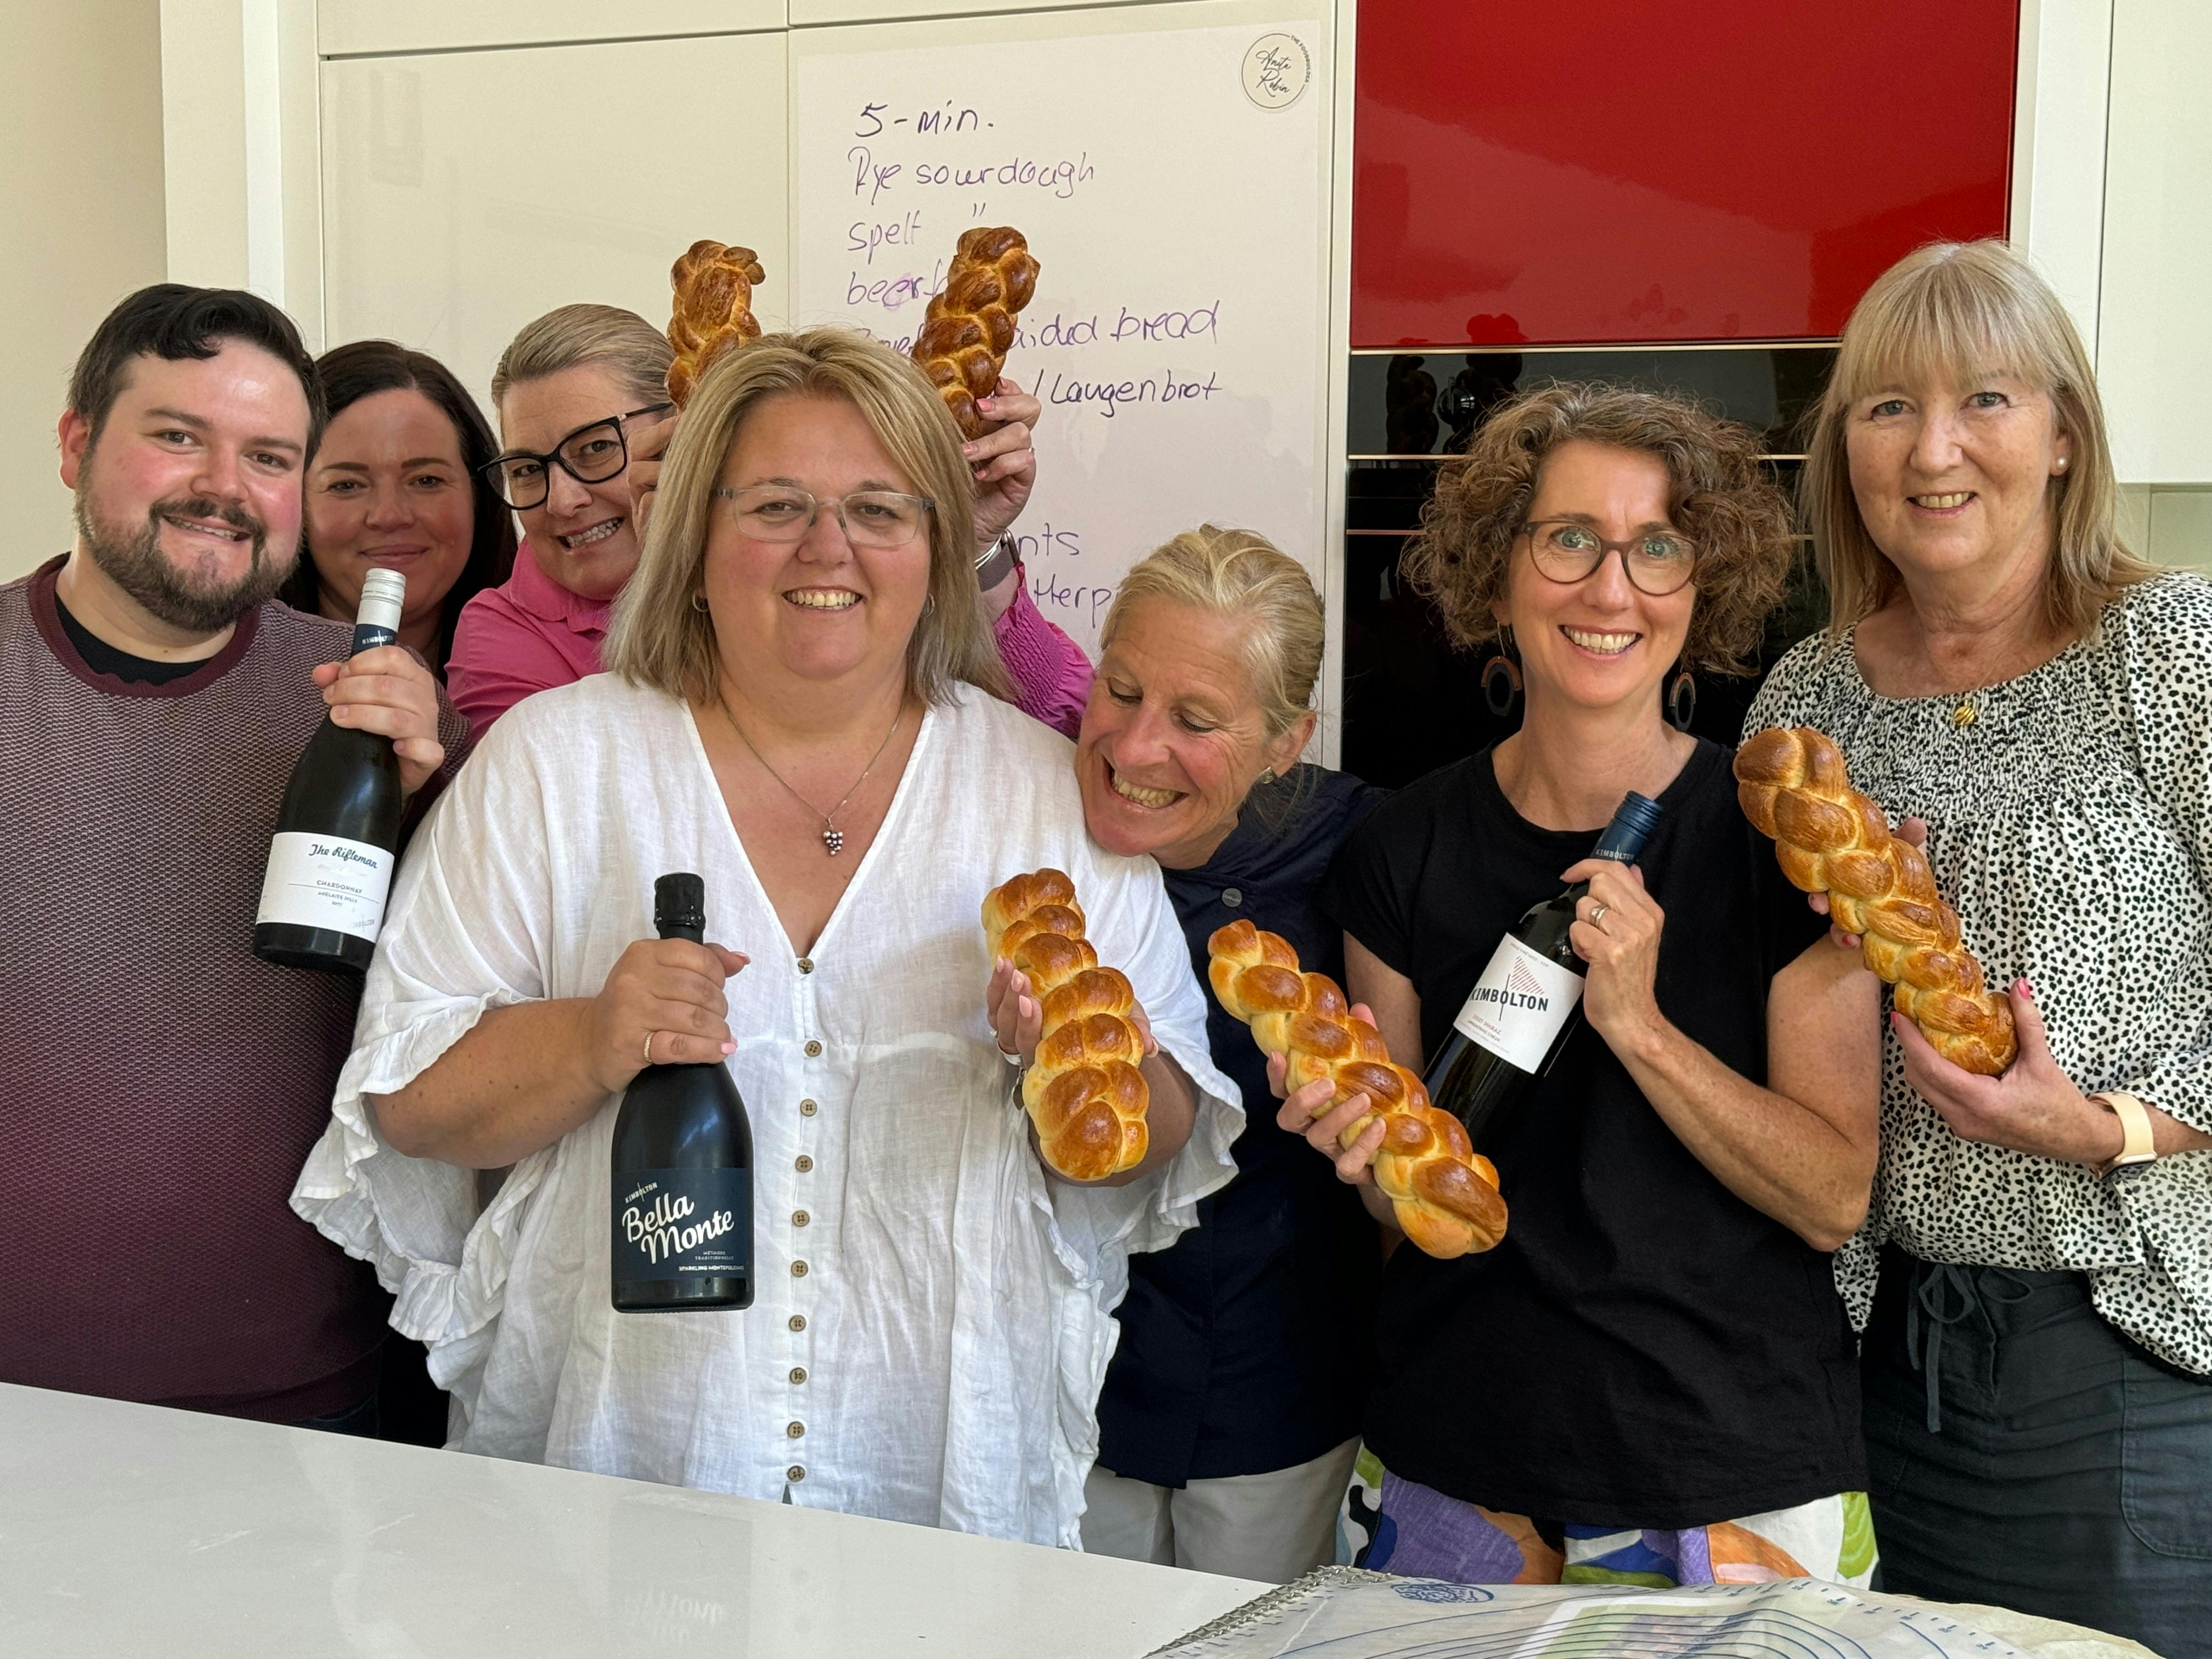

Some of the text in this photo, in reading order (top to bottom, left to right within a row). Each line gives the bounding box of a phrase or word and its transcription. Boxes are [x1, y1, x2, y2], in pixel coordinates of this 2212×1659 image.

[1255, 47, 1291, 71] Anita
[1256, 68, 1291, 97] Robin
[848, 146, 1093, 205] Rye sourdough
[848, 210, 921, 264] spelt
[1110, 300, 1220, 344] bread
[1015, 522, 1080, 556] nts
[1034, 573, 1111, 629] tterp
[362, 632, 393, 646] KIMBOLTON
[308, 844, 377, 869] The Rifleman
[1596, 847, 1635, 860] KIMBOLTON
[317, 879, 363, 894] CHARDONNAY
[1469, 981, 1549, 1016] KIMBOLTON
[624, 1182, 658, 1204] KIMBOLTON
[622, 1193, 695, 1243] Bella
[641, 1210, 735, 1265] Monte
